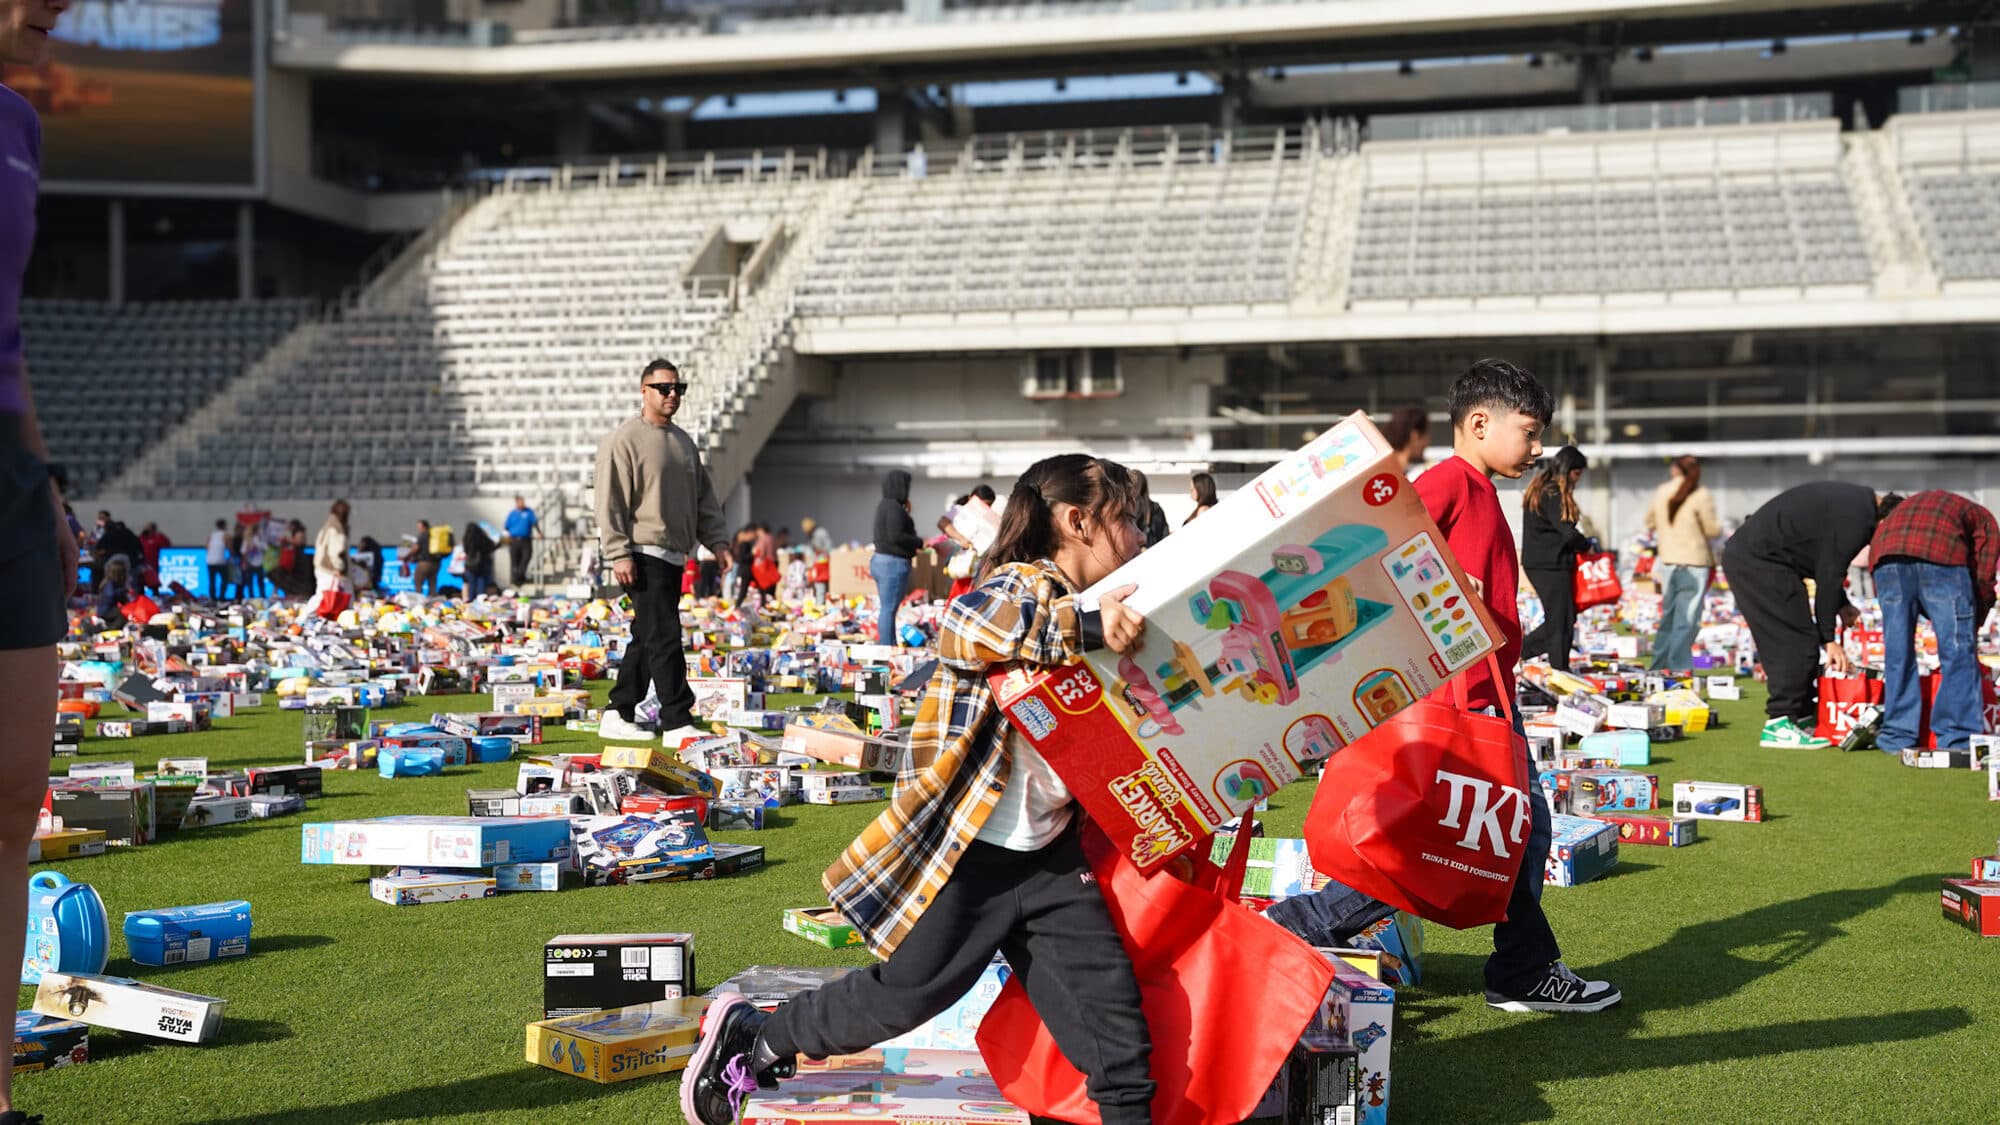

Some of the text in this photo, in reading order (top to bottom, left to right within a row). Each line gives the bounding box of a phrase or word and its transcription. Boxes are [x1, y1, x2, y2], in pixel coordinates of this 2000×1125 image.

[1372, 480, 1393, 502] 3+
[1578, 557, 1611, 582] TKF
[1054, 678, 1084, 706] 33
[1073, 668, 1098, 693] PCS
[1010, 700, 1049, 740] IMAGINE
[1028, 699, 1056, 728] ZONE
[1138, 761, 1180, 805] stand
[1111, 777, 1184, 852] MARKET
[1435, 769, 1530, 858] TKF
[1132, 835, 1162, 864] My
[1422, 853, 1449, 866] TRINA'S
[1450, 860, 1468, 872] KIDS
[236, 913, 247, 921] 3+
[1540, 975, 1571, 1001] N
[157, 1022, 193, 1035] STAR
[159, 1015, 193, 1028] WARS
[612, 1045, 668, 1074] Stitch
